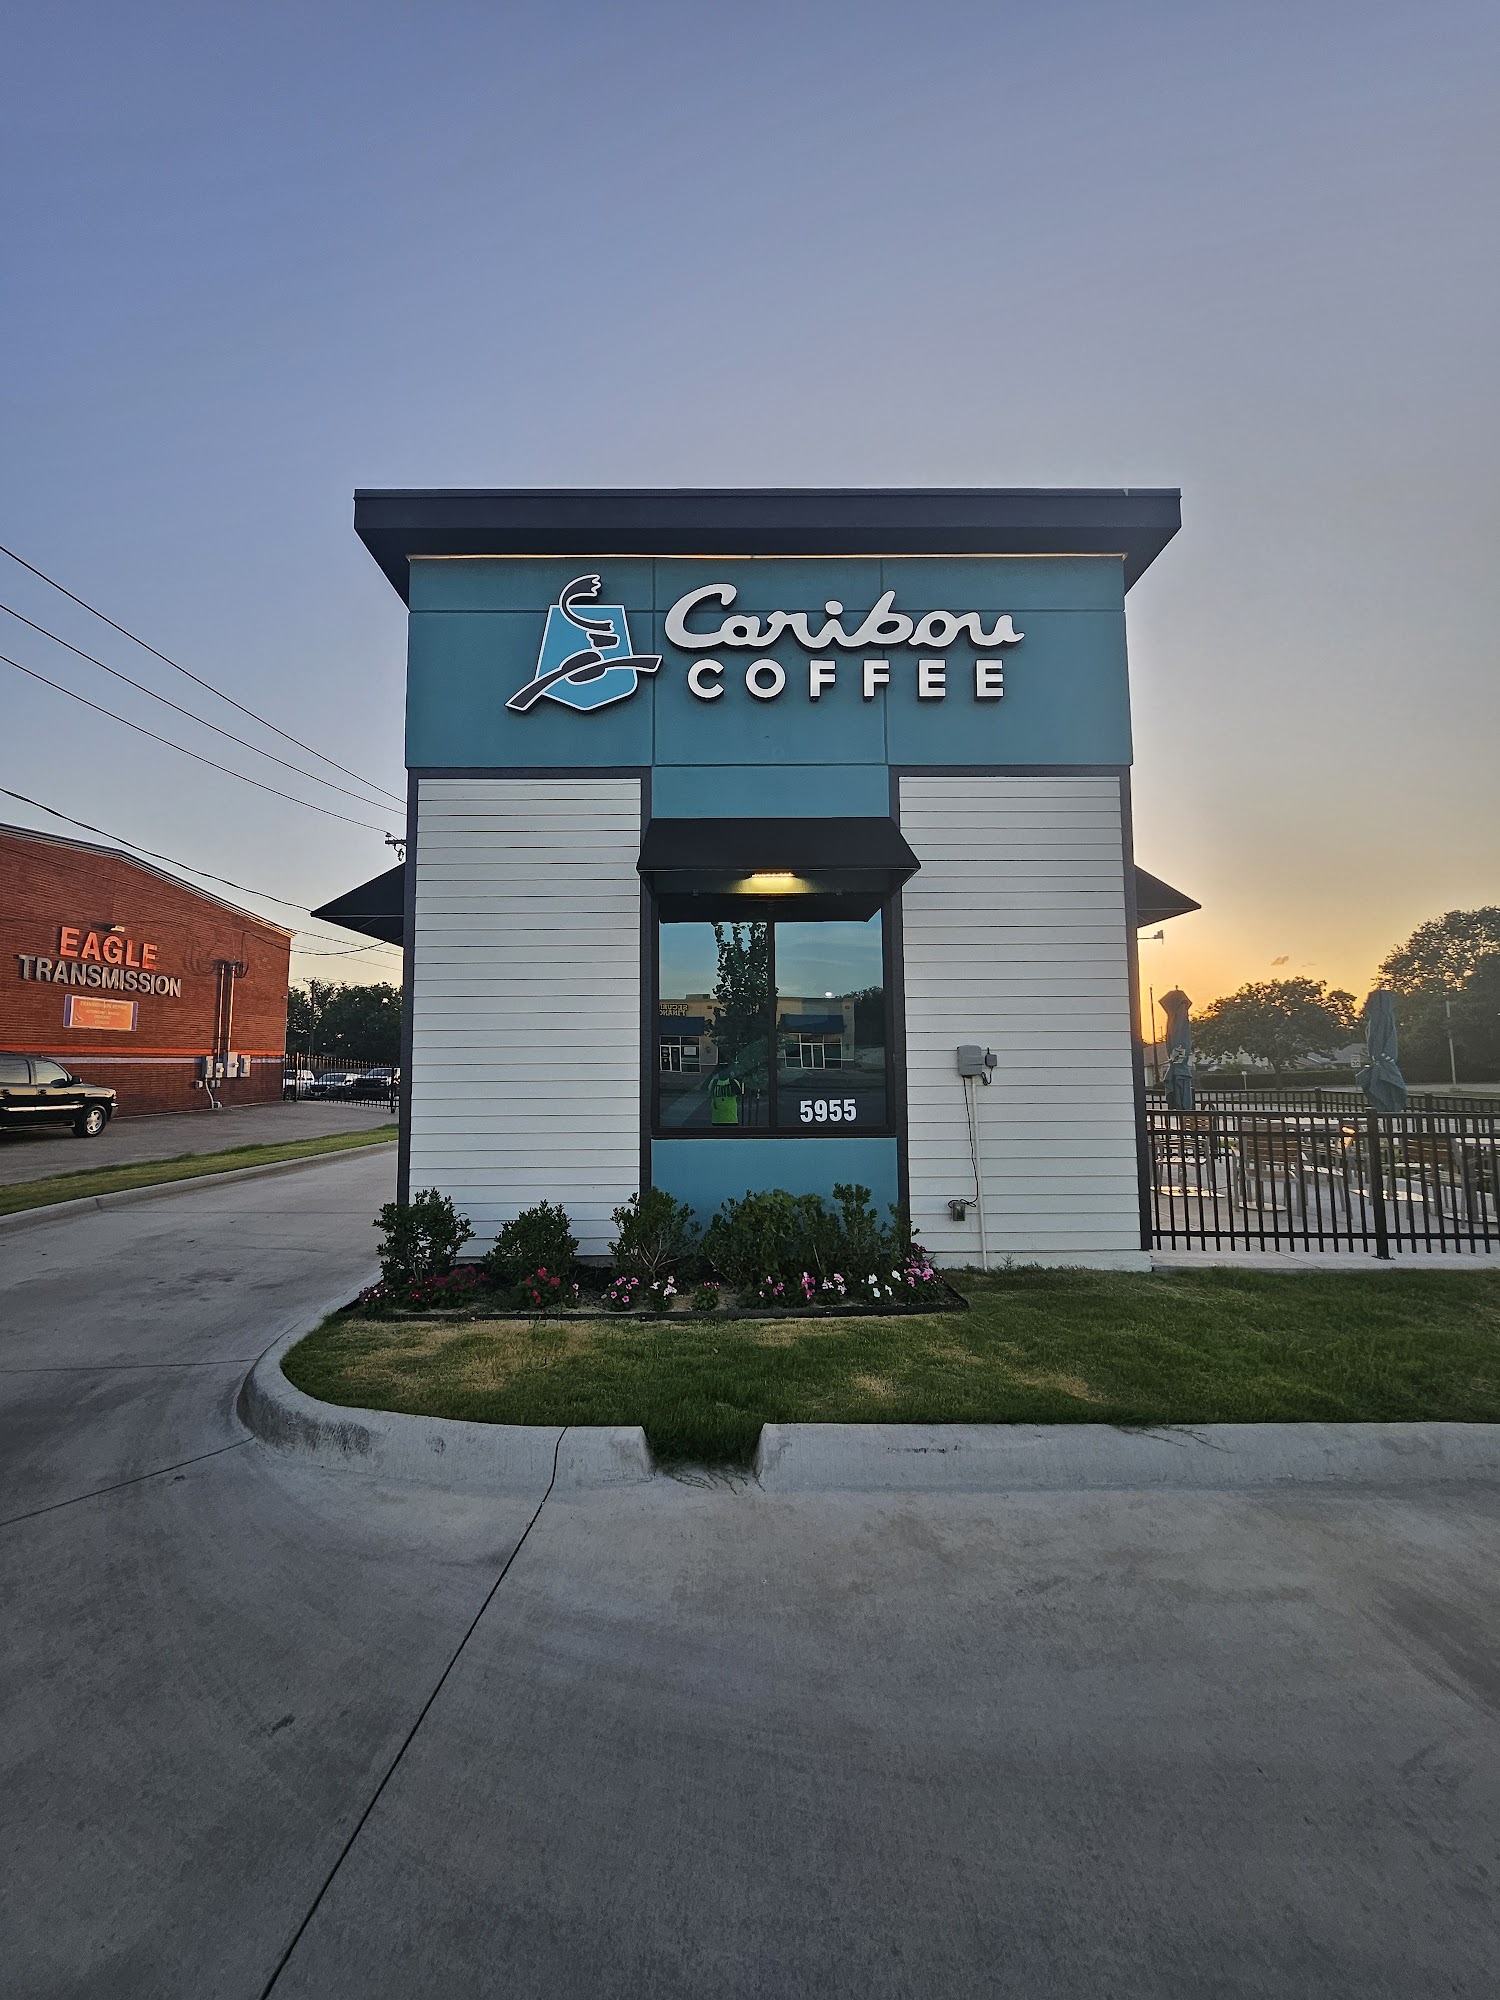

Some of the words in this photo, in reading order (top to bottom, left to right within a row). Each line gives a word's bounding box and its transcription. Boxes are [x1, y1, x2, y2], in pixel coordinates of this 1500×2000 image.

[664, 583, 1025, 649] Caribou
[687, 658, 1004, 699] COFFEE
[59, 926, 158, 970] EAGLE
[18, 954, 182, 998] TRANSMISSION
[800, 1099, 857, 1123] 5955
